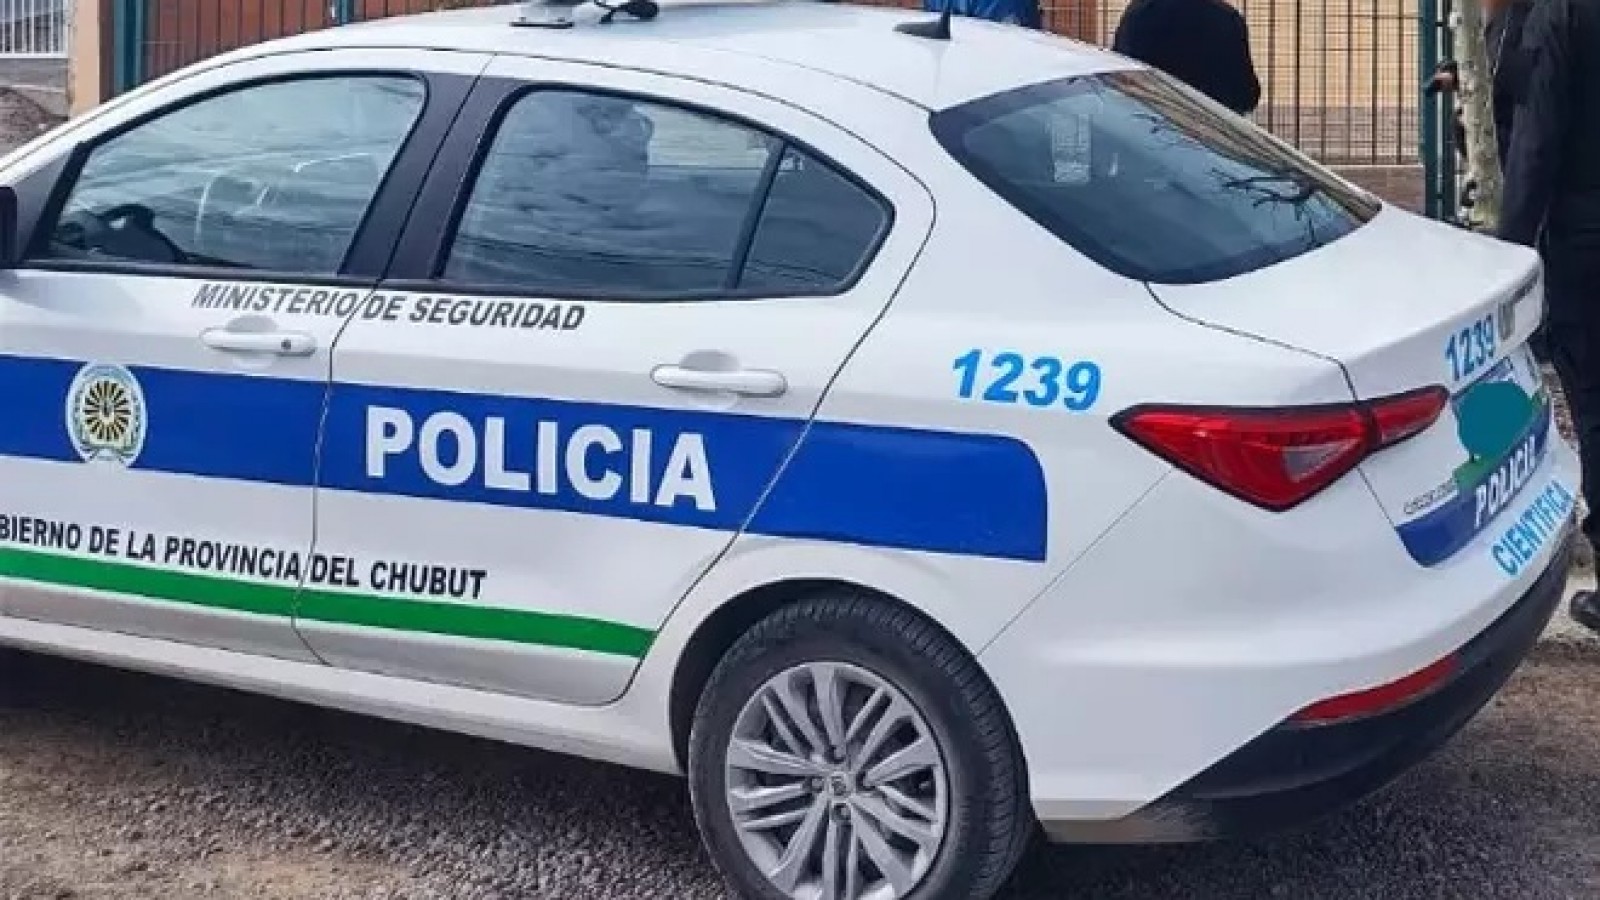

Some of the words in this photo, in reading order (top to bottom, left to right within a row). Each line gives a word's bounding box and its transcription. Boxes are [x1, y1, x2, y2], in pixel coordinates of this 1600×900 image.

[191, 283, 359, 318] MINISTERIO
[361, 295, 406, 320] DE
[410, 299, 586, 331] SEGURIDAD
[953, 349, 1101, 411] 1239
[1445, 313, 1494, 381] 1239
[366, 404, 716, 512] POLICIA
[1475, 435, 1536, 528] POLICIA
[88, 525, 121, 556] DE
[126, 530, 157, 562] LA
[164, 536, 300, 581] PROVINCIA
[311, 555, 361, 588] DEL
[370, 562, 487, 600] CHUBUT
